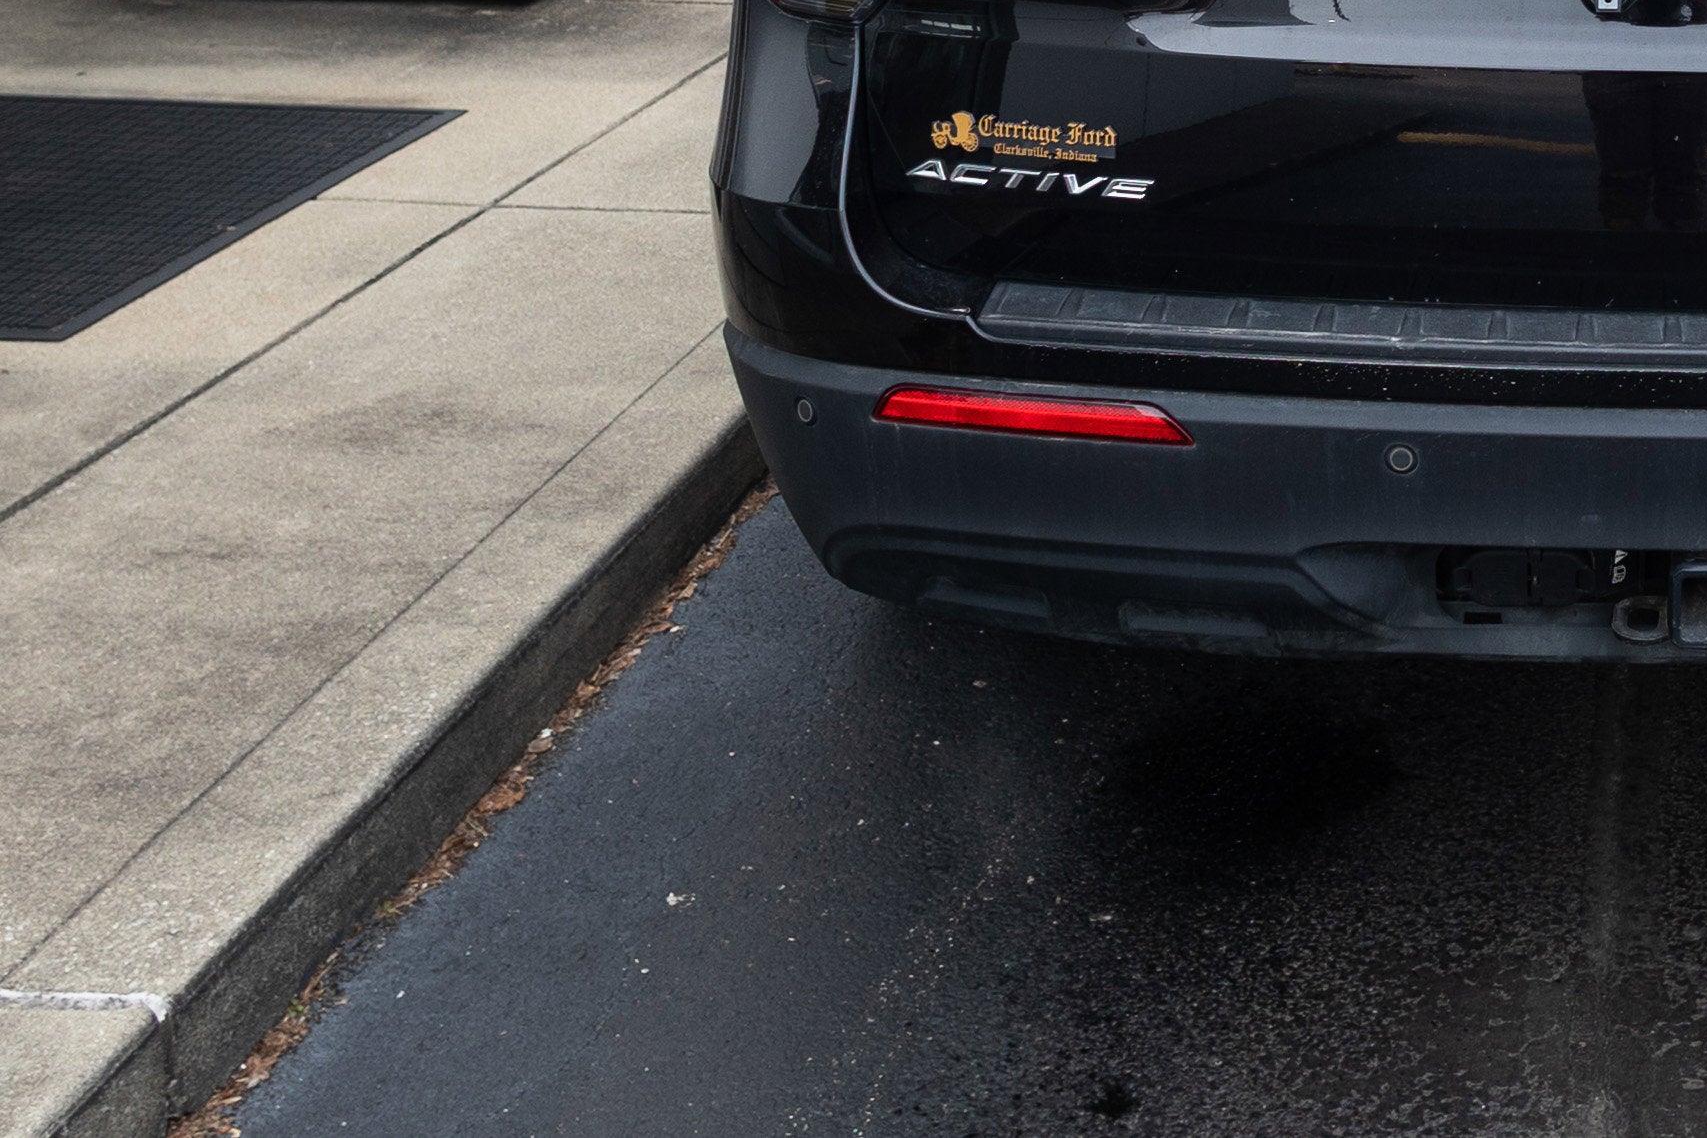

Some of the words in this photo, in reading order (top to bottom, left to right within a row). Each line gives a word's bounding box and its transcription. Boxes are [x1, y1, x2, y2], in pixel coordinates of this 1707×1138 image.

[977, 114, 1061, 145] Carriage
[1065, 121, 1118, 148] Ford
[905, 159, 1155, 200] ACTIVE
